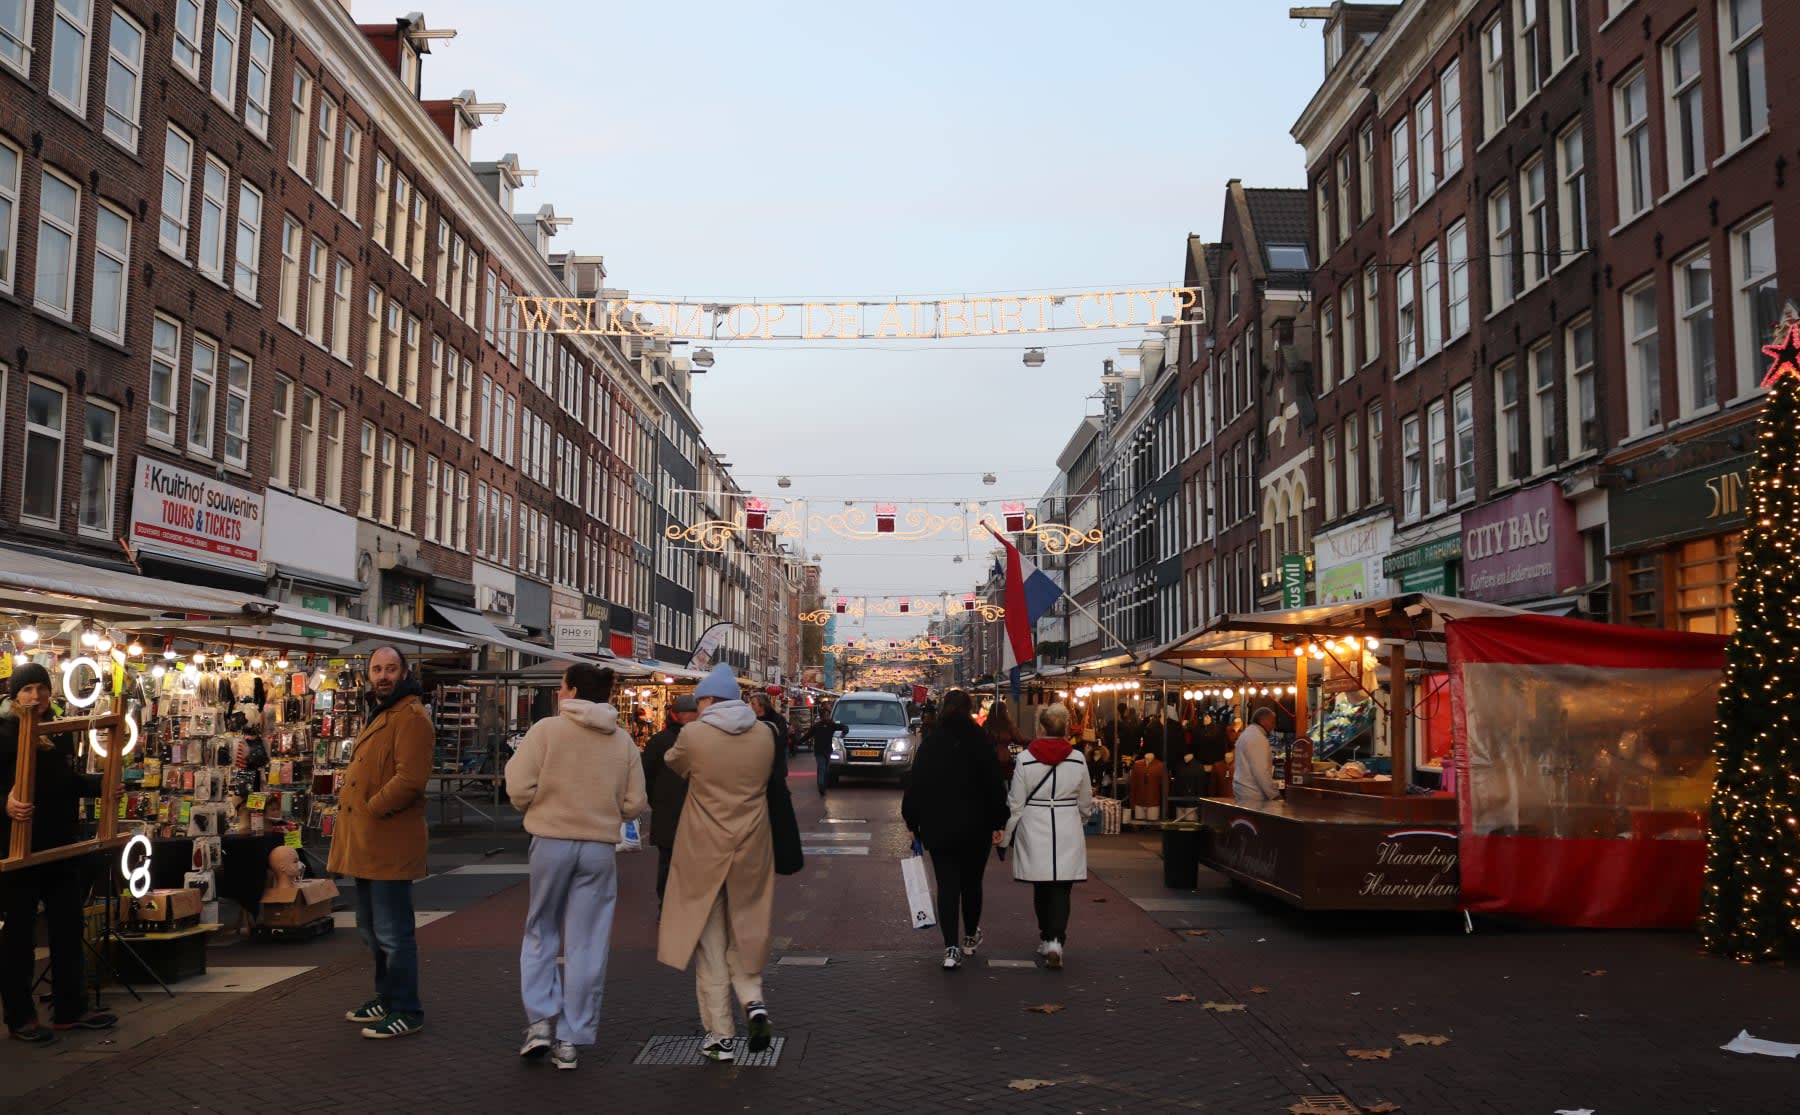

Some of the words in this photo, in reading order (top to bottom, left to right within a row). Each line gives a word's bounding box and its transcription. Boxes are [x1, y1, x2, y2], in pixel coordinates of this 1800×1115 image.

[517, 296, 703, 337] WELKOM
[727, 303, 785, 339] OP
[802, 303, 862, 339] DE
[874, 295, 1055, 339] ALBERT
[1075, 287, 1198, 329] CUYP
[150, 466, 205, 504] Kruithof
[206, 489, 258, 521] souvenirs
[162, 499, 195, 530] TOURS
[195, 510, 203, 532] &
[205, 511, 242, 542] TICKETS
[1466, 520, 1505, 562] CITY
[1507, 507, 1551, 551] BAG
